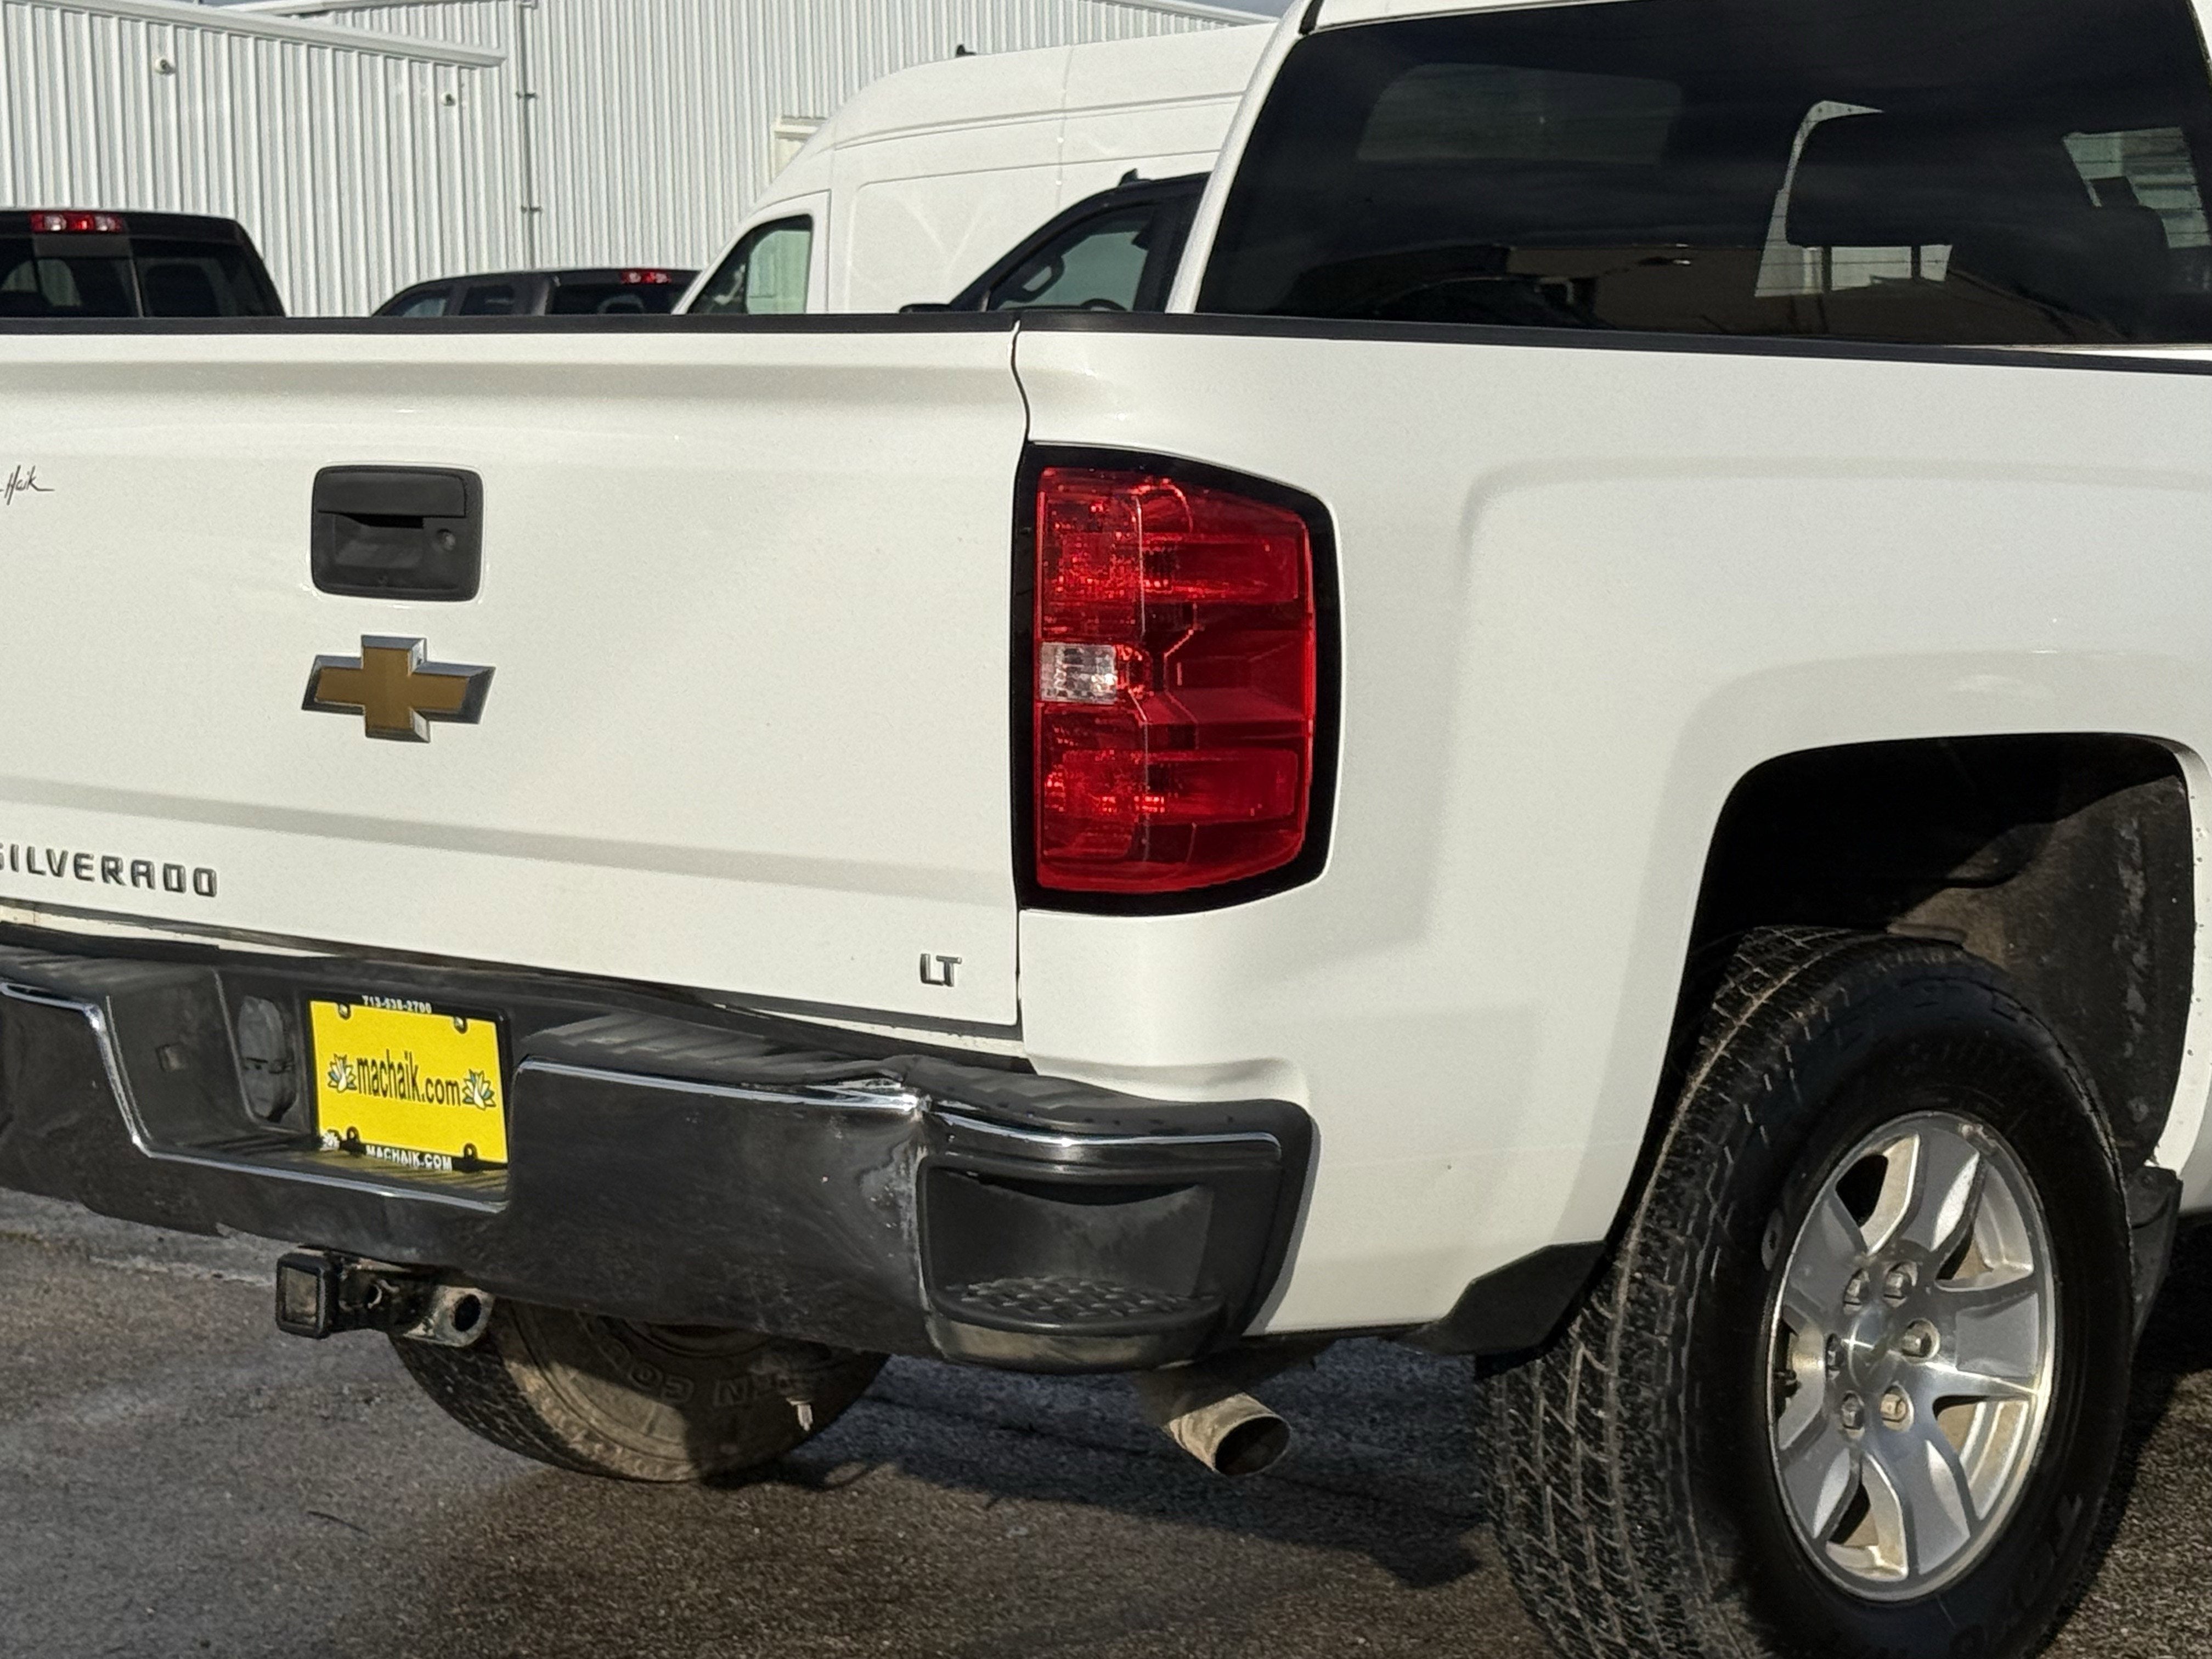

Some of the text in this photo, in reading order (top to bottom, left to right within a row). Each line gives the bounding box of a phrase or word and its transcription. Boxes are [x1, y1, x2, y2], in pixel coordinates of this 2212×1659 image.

[0, 843, 217, 897] ILVERADO
[920, 953, 962, 988] LT
[356, 1048, 461, 1107] machaik.com
[365, 1144, 453, 1171] MACHAIK.COM
